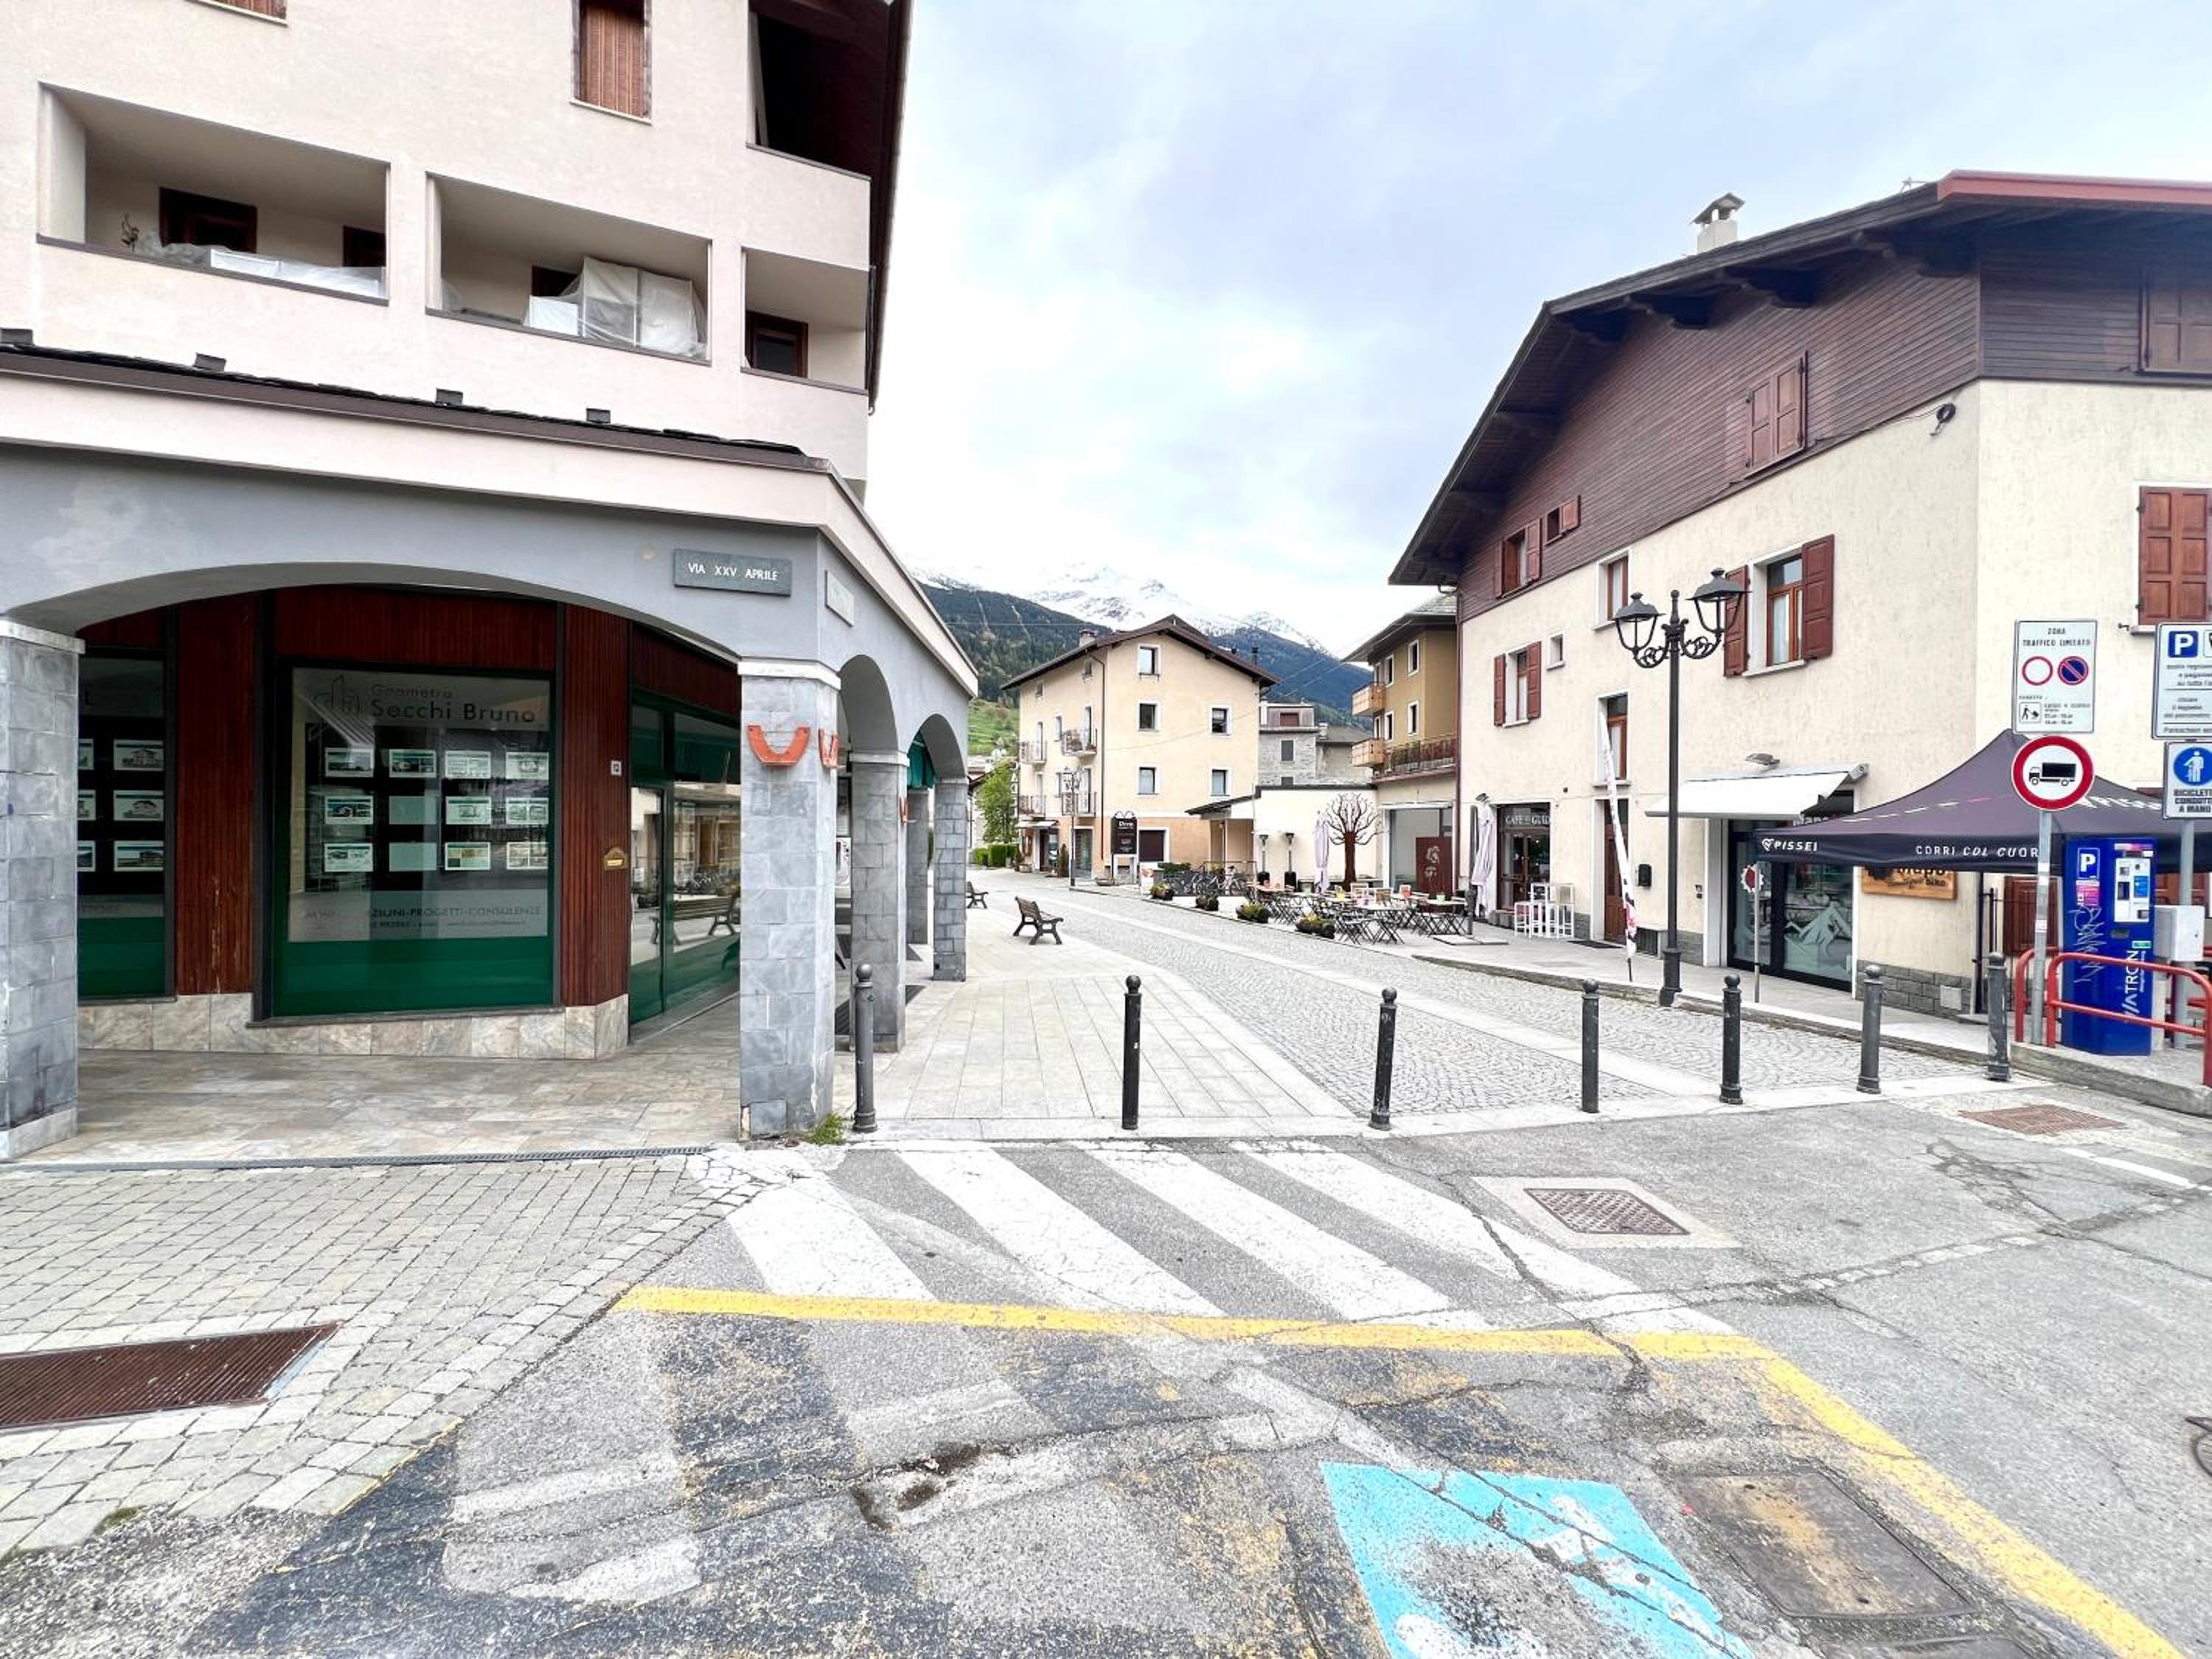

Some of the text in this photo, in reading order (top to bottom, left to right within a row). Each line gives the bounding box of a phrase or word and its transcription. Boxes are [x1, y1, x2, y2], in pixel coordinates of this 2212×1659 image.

[688, 563, 779, 581] VIA XXV APRILE
[372, 700, 536, 724] Secchi Bruno
[1774, 841, 1818, 852] PISSEI
[1916, 846, 2038, 858] CORRI COL CUOR
